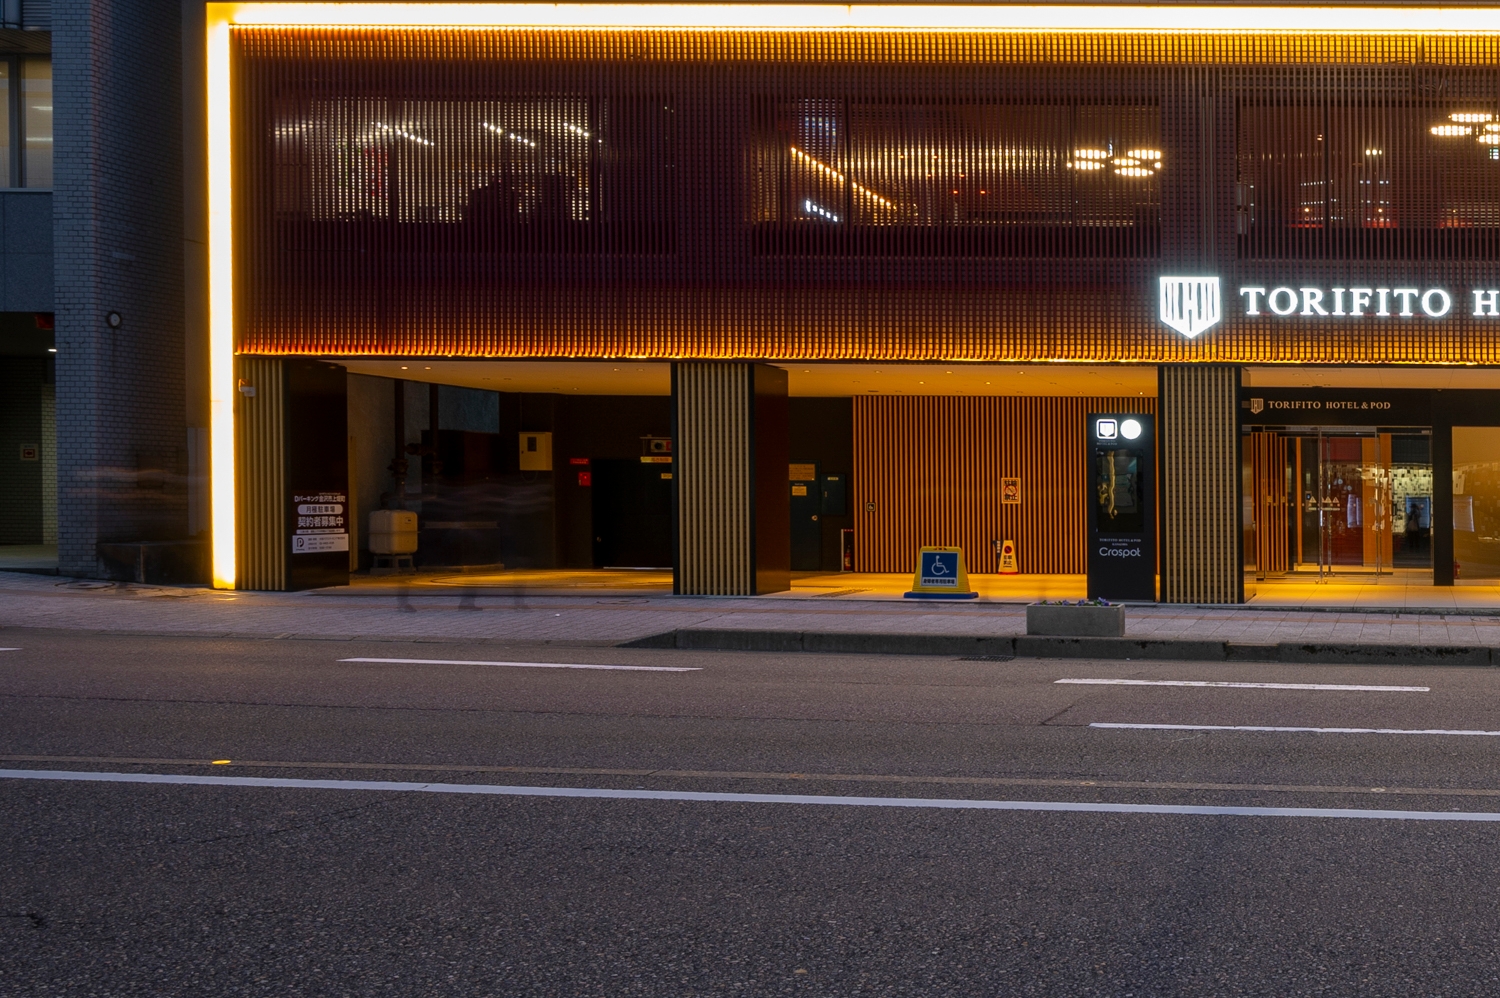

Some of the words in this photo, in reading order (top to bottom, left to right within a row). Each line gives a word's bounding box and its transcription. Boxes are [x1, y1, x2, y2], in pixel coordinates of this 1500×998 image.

[1240, 287, 1451, 317] TORIFITO
[1268, 401, 1321, 409] TORIFITO
[298, 516, 344, 527] 契約者募集中
[1099, 547, 1141, 558] Crospot
